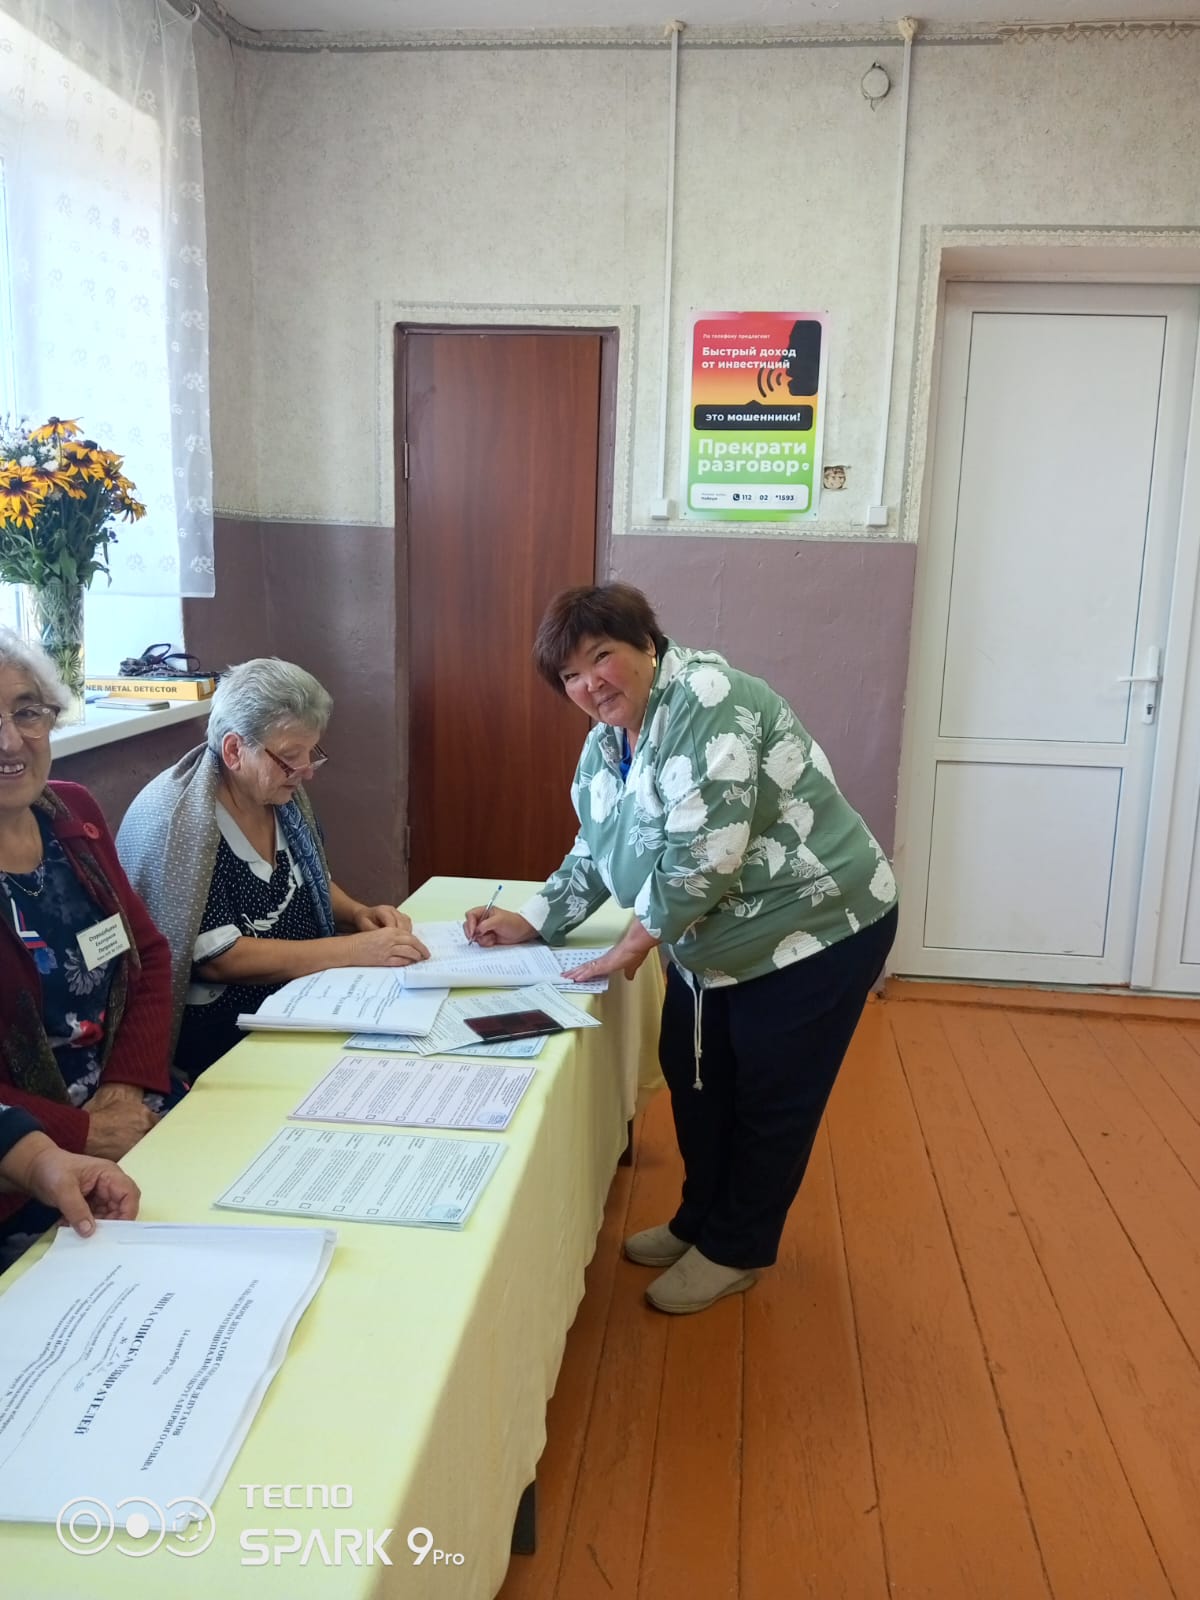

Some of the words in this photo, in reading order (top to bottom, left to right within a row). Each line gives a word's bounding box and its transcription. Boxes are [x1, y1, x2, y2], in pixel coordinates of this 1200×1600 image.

[702, 346, 757, 358] Быстрый
[759, 348, 797, 358] доход
[701, 361, 716, 369] от
[718, 359, 791, 370] инвестиций
[705, 413, 725, 422] это
[727, 412, 801, 422] мошенники!
[698, 438, 807, 458] Прекрати
[134, 686, 177, 694] DETECTOR
[149, 1292, 176, 1316] КНИГА
[124, 1316, 155, 1362] СПИСКА
[74, 1362, 130, 1435] ИЗБИРАТЕЛЕЙ
[172, 1389, 200, 1436] ДЕПУТАТОВ
